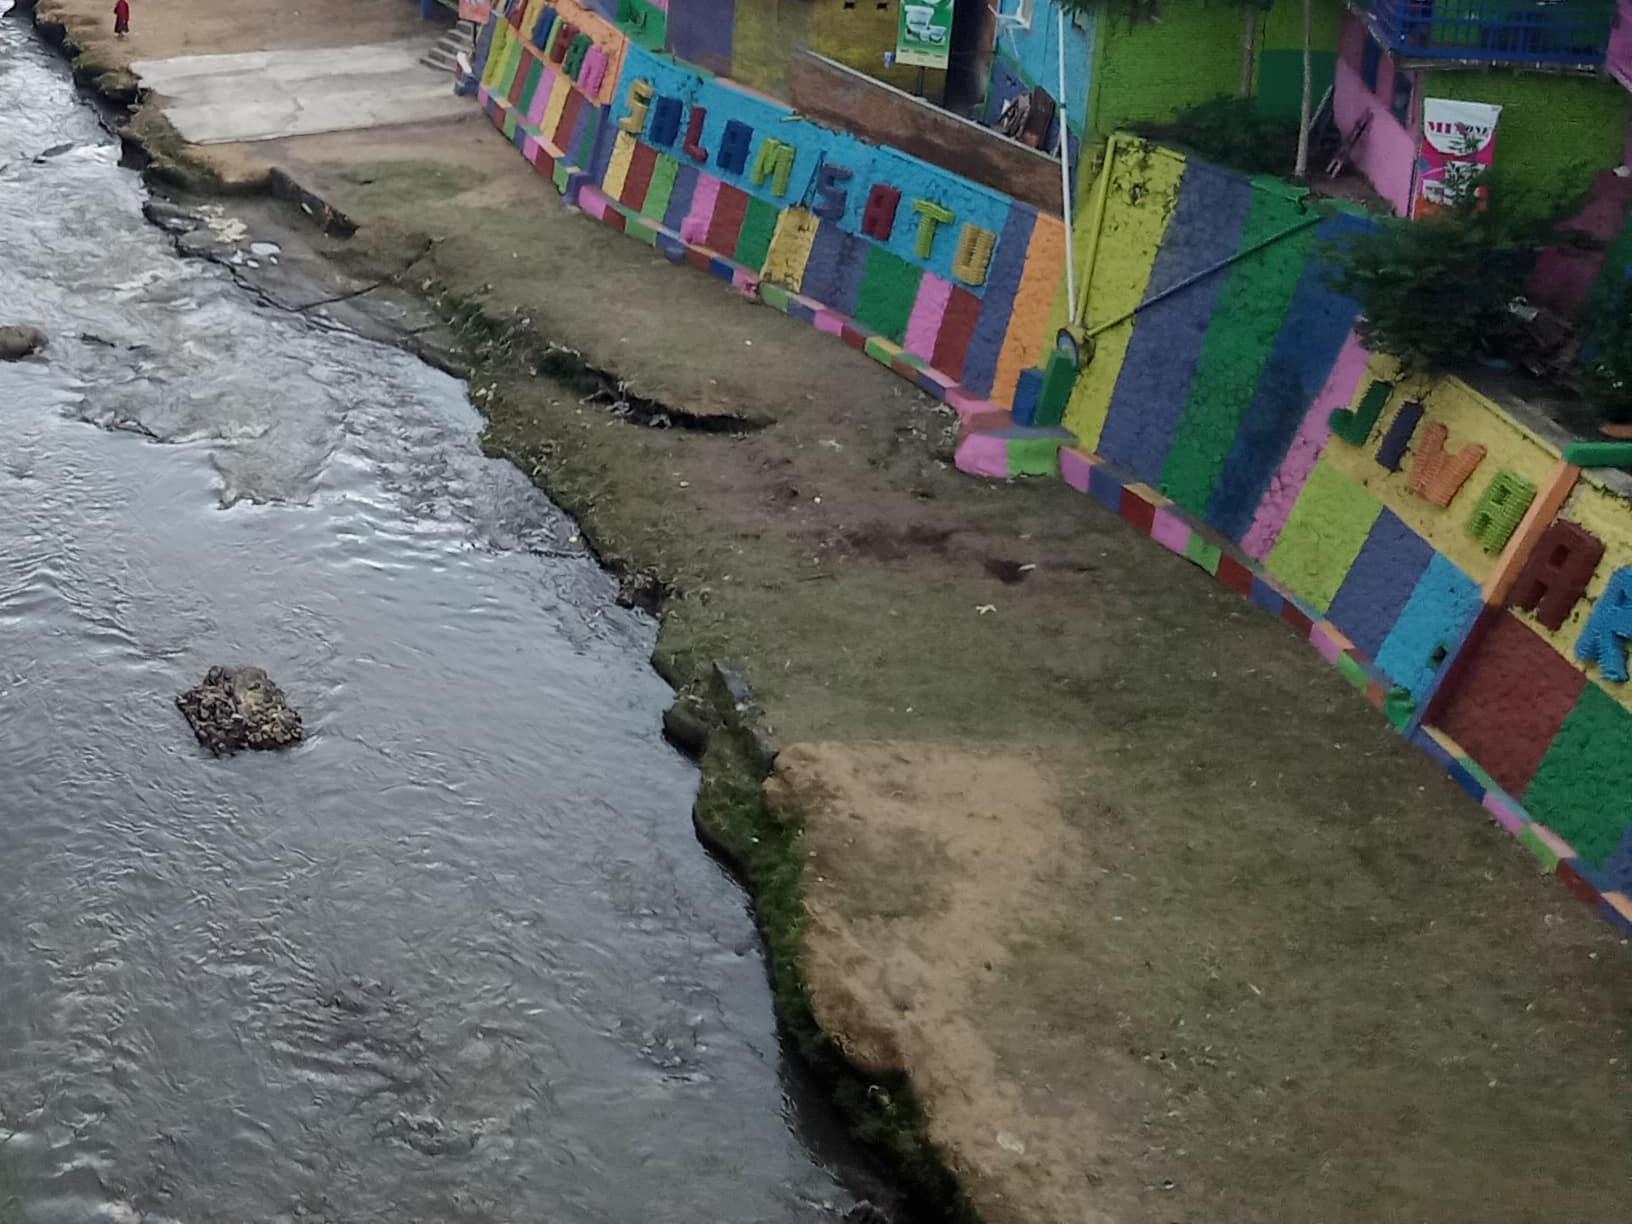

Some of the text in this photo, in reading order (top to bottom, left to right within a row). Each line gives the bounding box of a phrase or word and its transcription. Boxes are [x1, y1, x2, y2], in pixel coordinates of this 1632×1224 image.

[617, 77, 998, 287] SALAM SATU
[1326, 378, 1538, 553] JIWA
